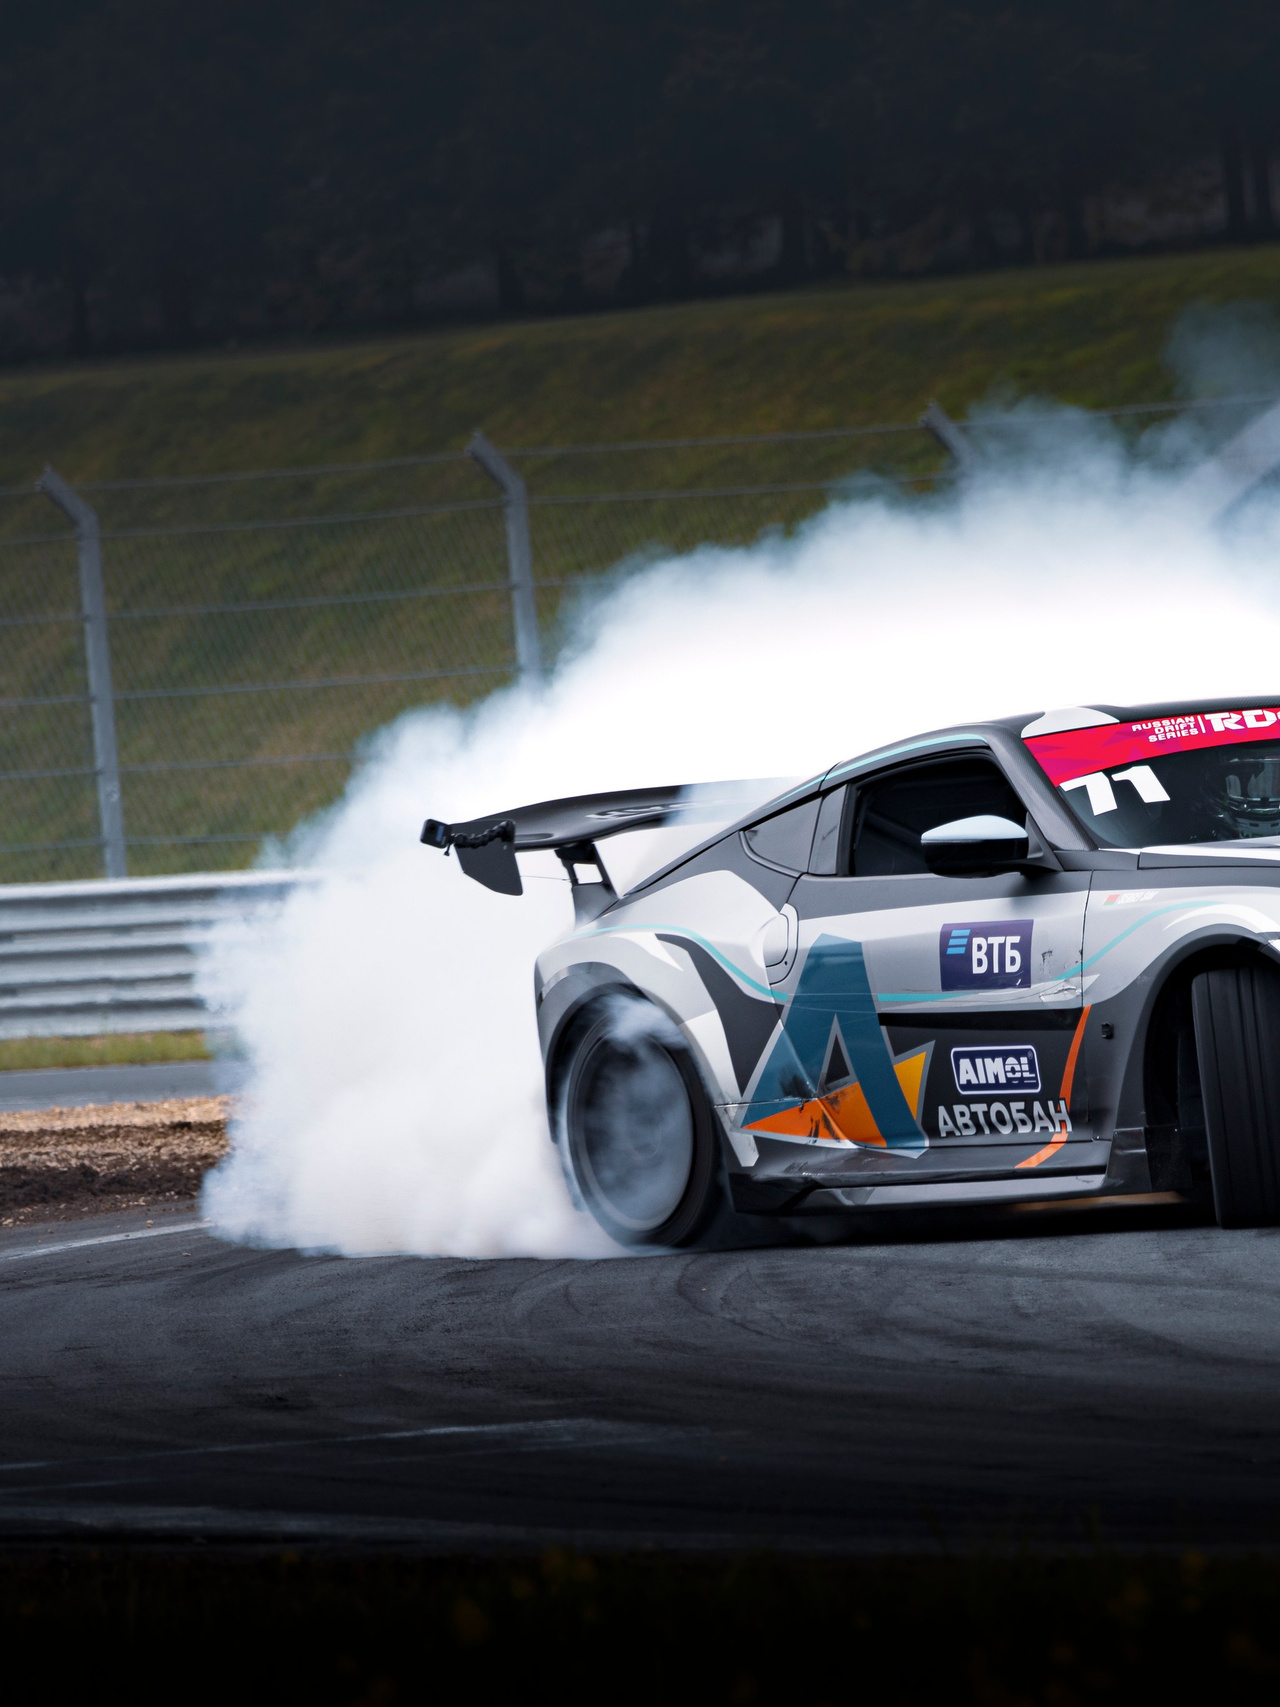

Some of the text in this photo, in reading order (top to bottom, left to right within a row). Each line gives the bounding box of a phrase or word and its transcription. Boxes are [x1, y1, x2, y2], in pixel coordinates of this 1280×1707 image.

[1131, 715, 1196, 732] RUSSIAN
[1148, 727, 1199, 743] SERIES
[1154, 722, 1197, 735] DRIFT
[1059, 765, 1171, 816] 71
[971, 935, 1021, 974] ВТБ
[959, 1056, 1037, 1085] AIMOL
[938, 1099, 1073, 1137] АВТОБАН
